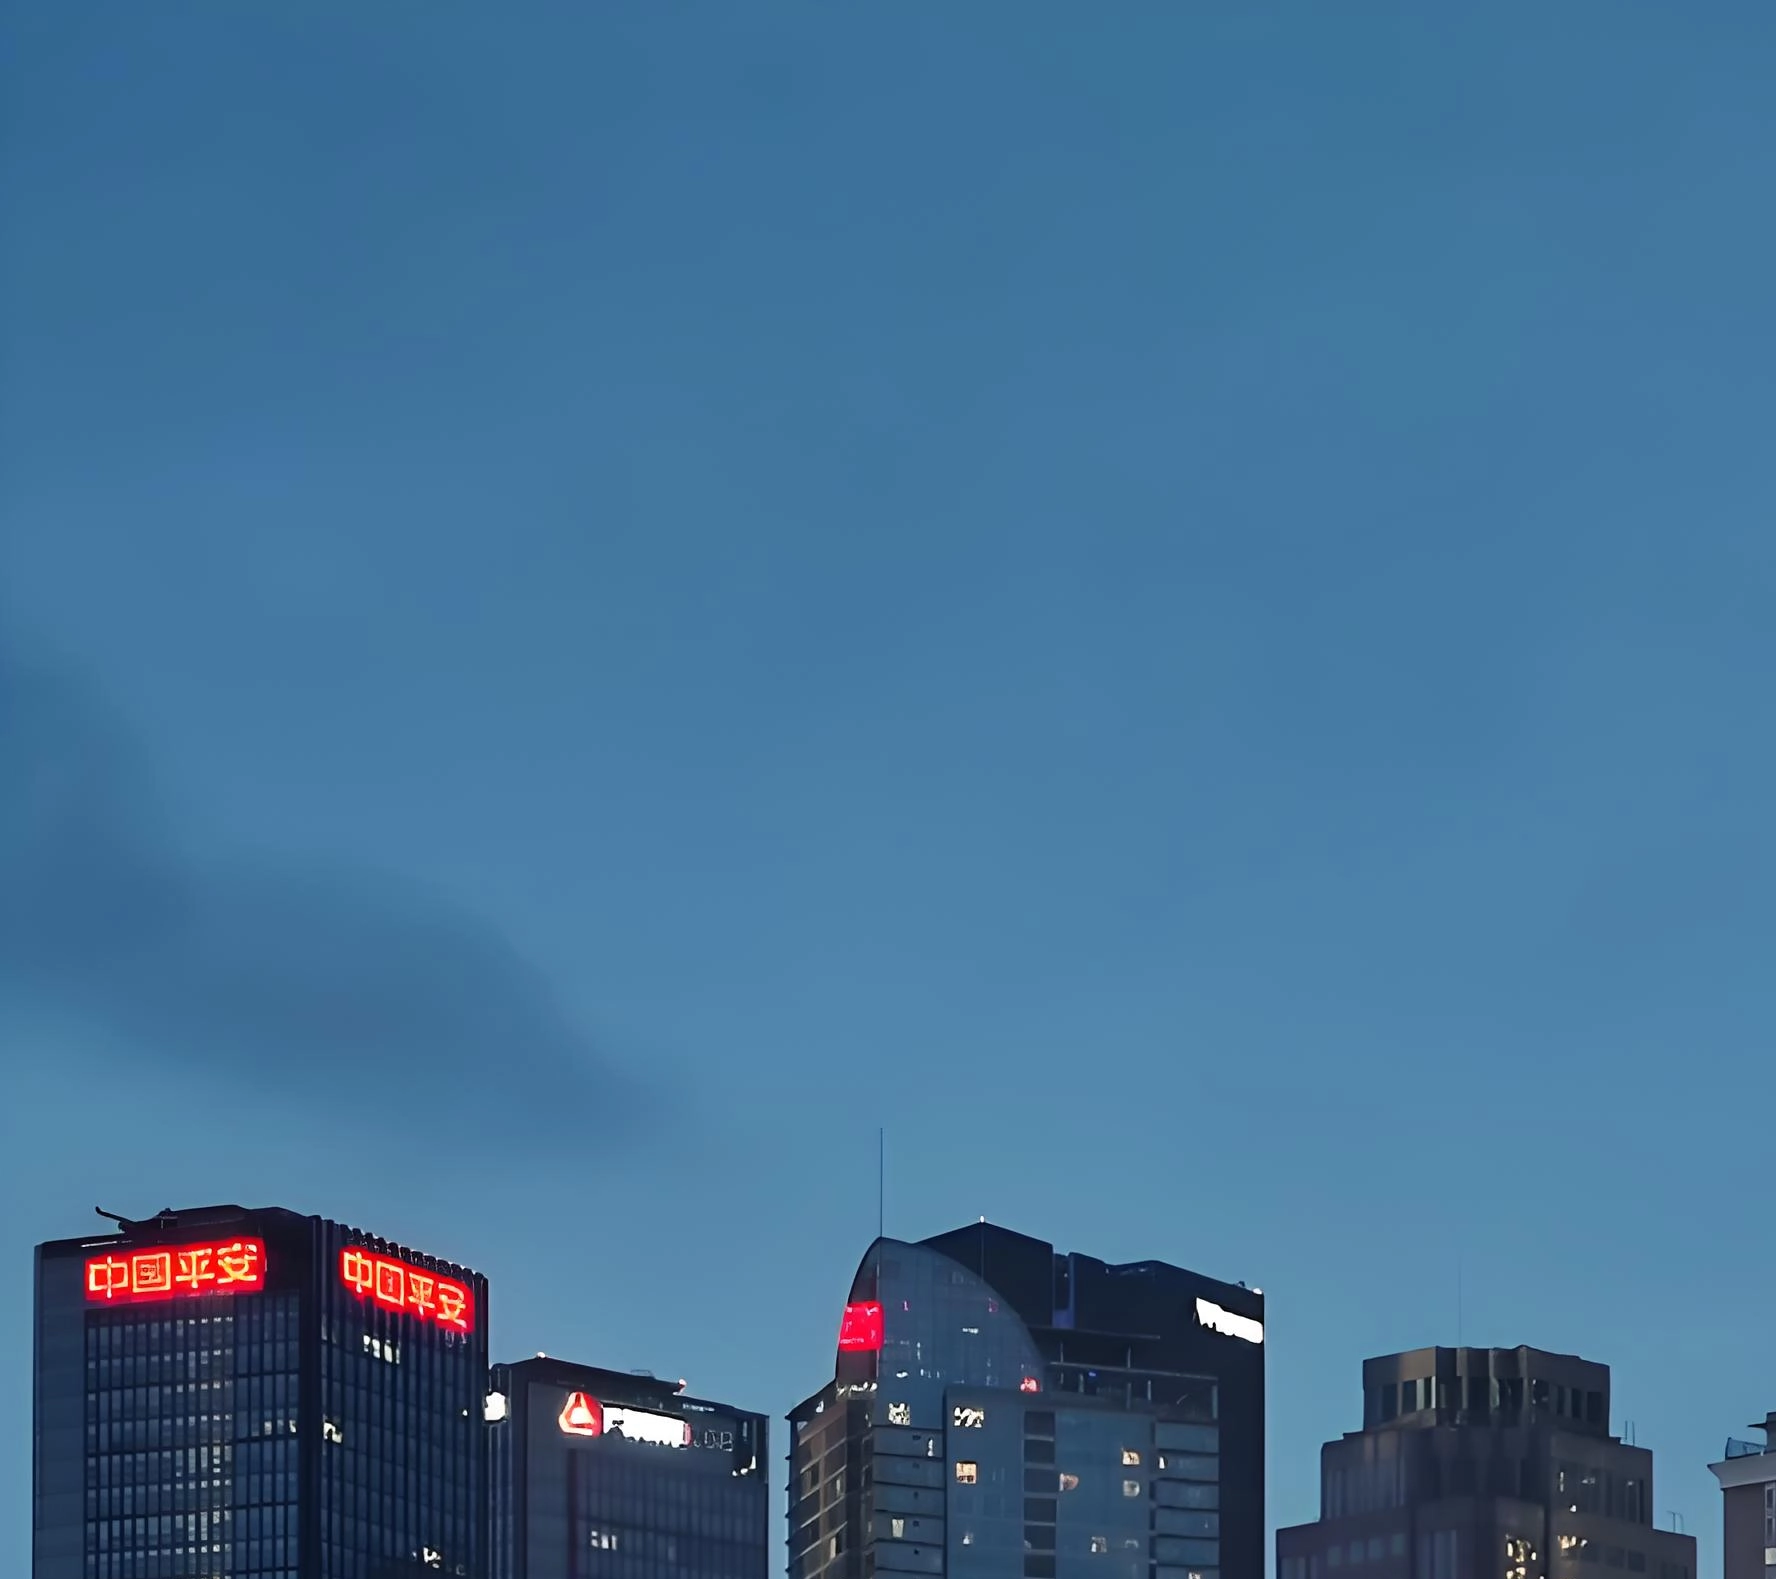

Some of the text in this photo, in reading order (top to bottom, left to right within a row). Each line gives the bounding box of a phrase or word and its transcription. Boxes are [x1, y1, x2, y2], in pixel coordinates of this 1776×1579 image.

[88, 1242, 258, 1299] 中国平安
[343, 1251, 468, 1328] 中国平安
